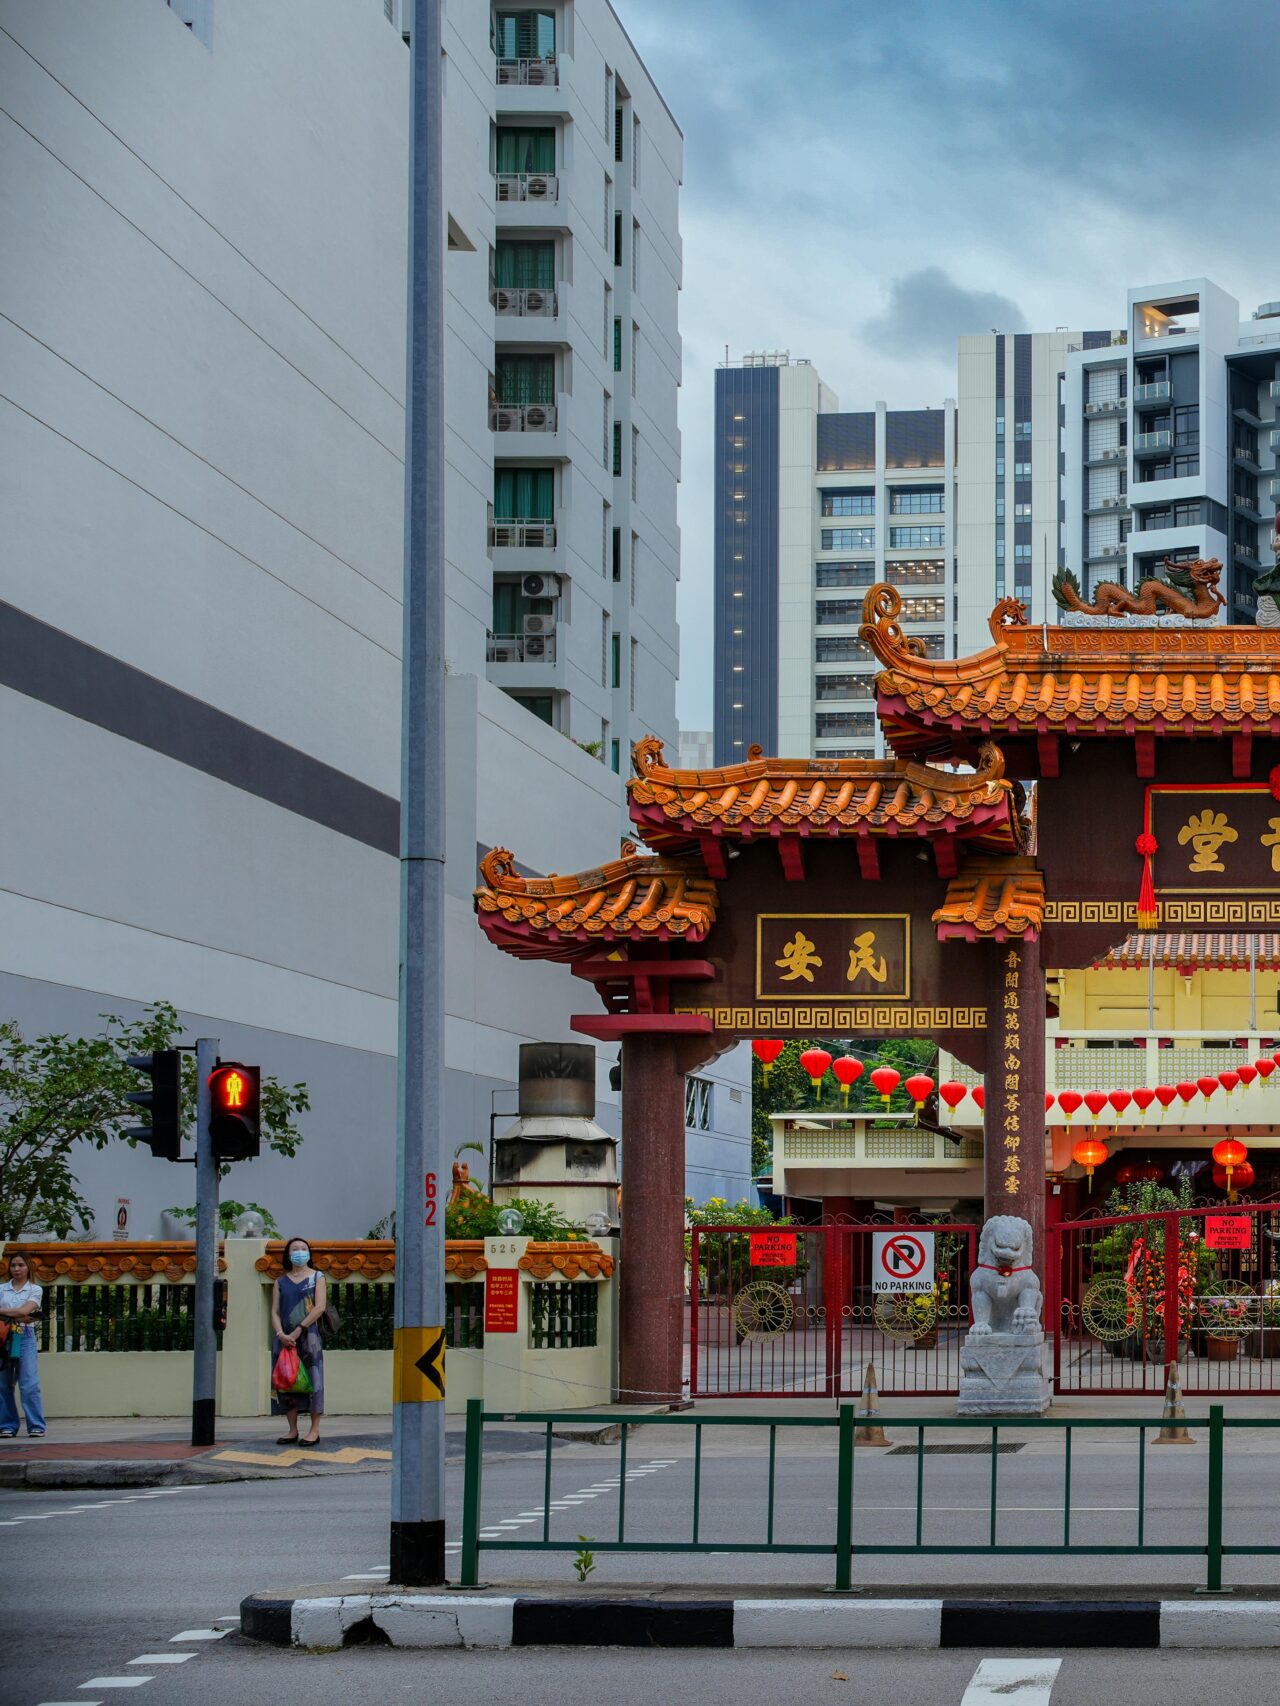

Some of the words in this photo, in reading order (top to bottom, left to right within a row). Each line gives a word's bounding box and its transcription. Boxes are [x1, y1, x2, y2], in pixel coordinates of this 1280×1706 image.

[1222, 1219, 1235, 1227] NO
[767, 1235, 780, 1243] NO
[490, 1244, 517, 1254] 525
[754, 1243, 793, 1251] PARKING
[875, 1281, 888, 1291] NO
[890, 1281, 932, 1291] PARKING
